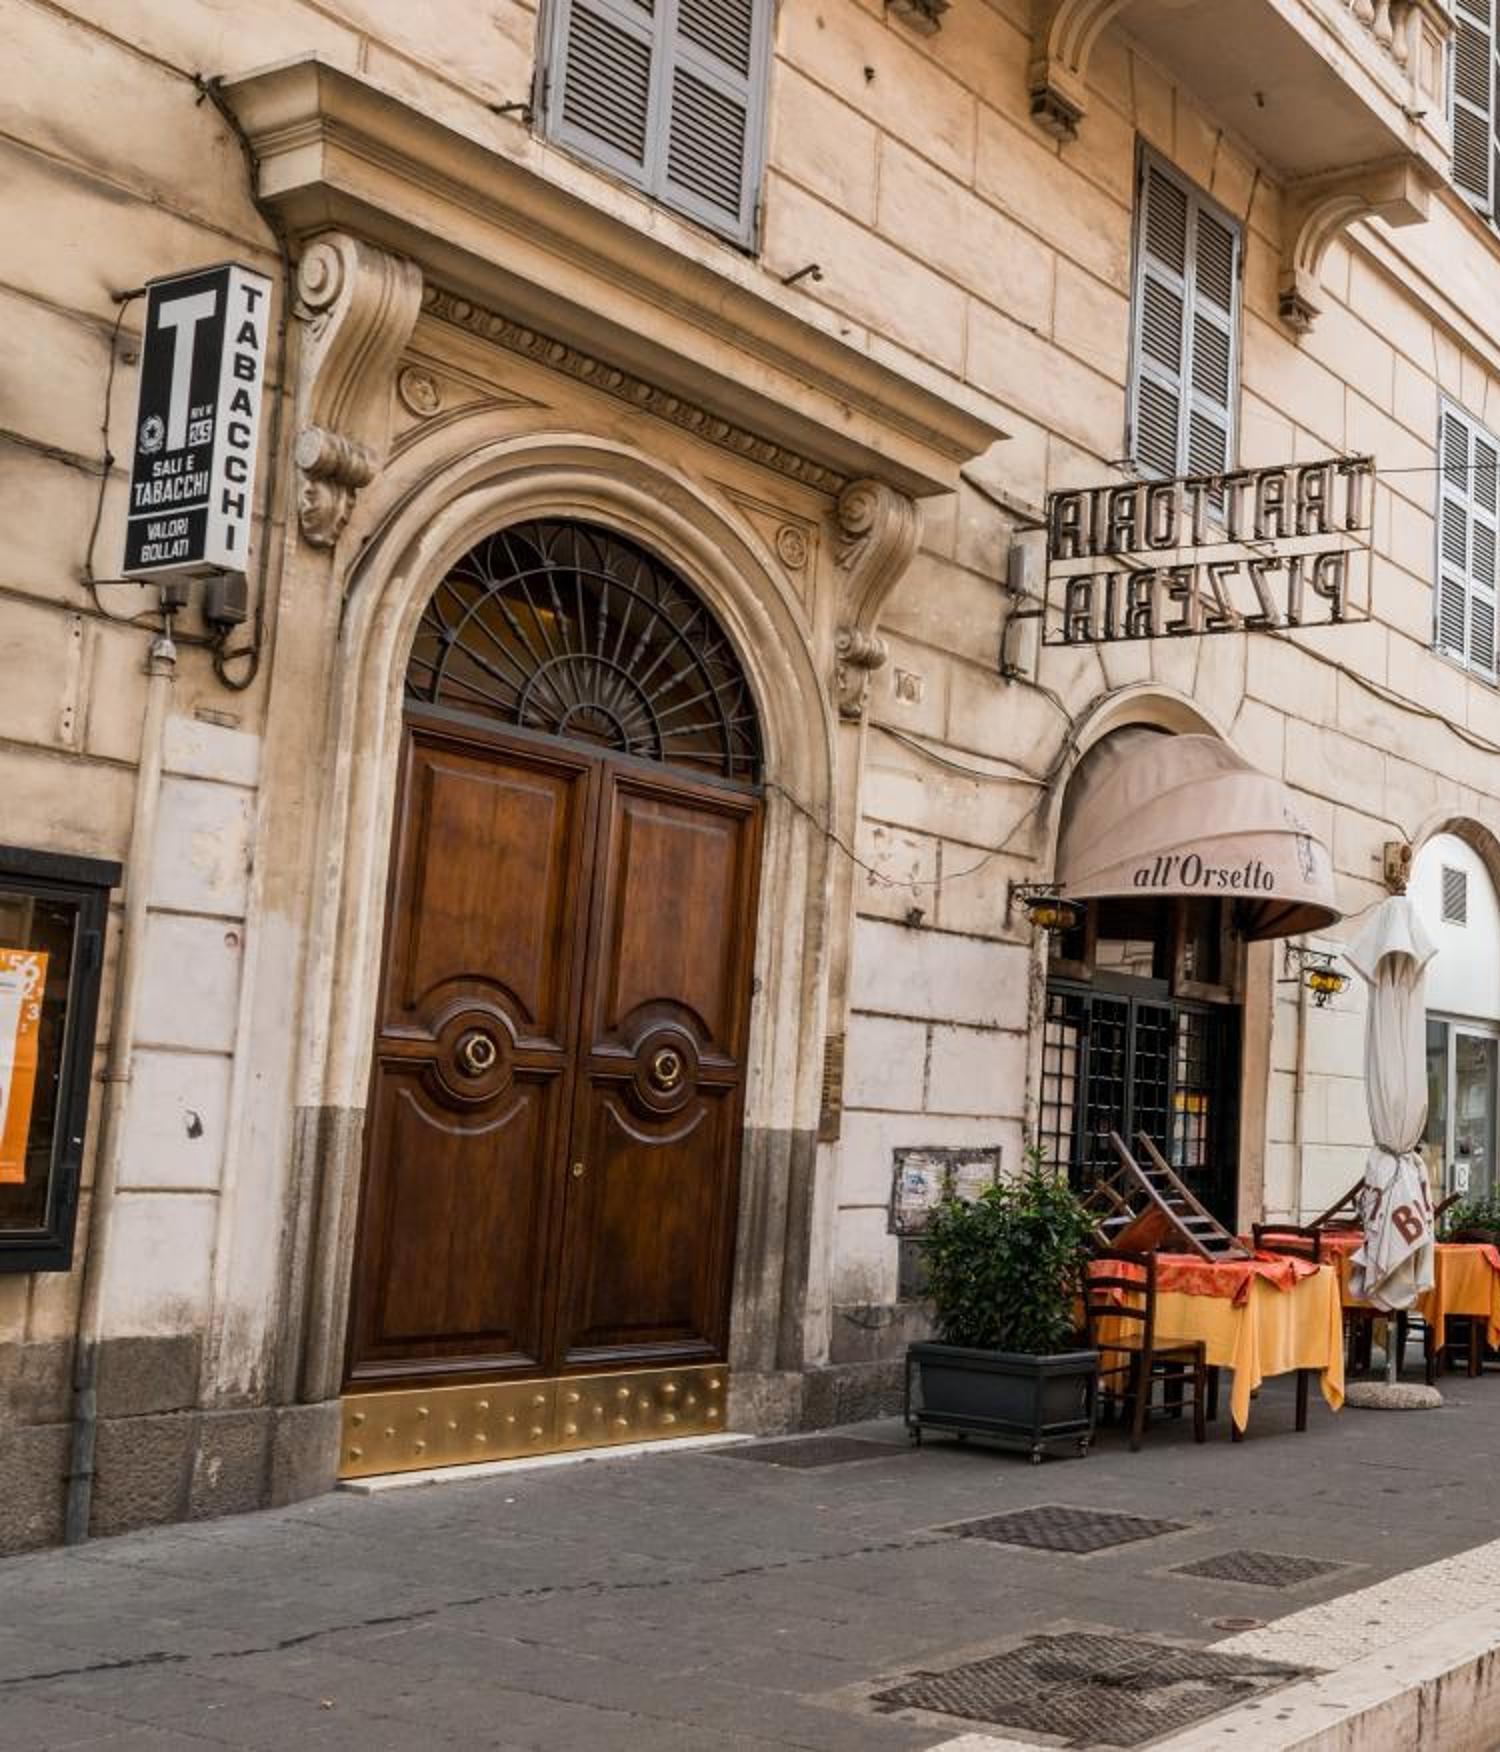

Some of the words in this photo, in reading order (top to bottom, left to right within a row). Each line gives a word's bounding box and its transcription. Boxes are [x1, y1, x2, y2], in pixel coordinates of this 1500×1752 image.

[158, 289, 217, 451] T
[221, 284, 262, 550] TABACCHI
[152, 457, 183, 477] SALI
[186, 454, 196, 471] E
[134, 471, 208, 507] TABACCHI
[147, 517, 189, 541] VALORI
[140, 540, 189, 562] BOLLATI
[1133, 854, 1275, 891] all'Orsetto
